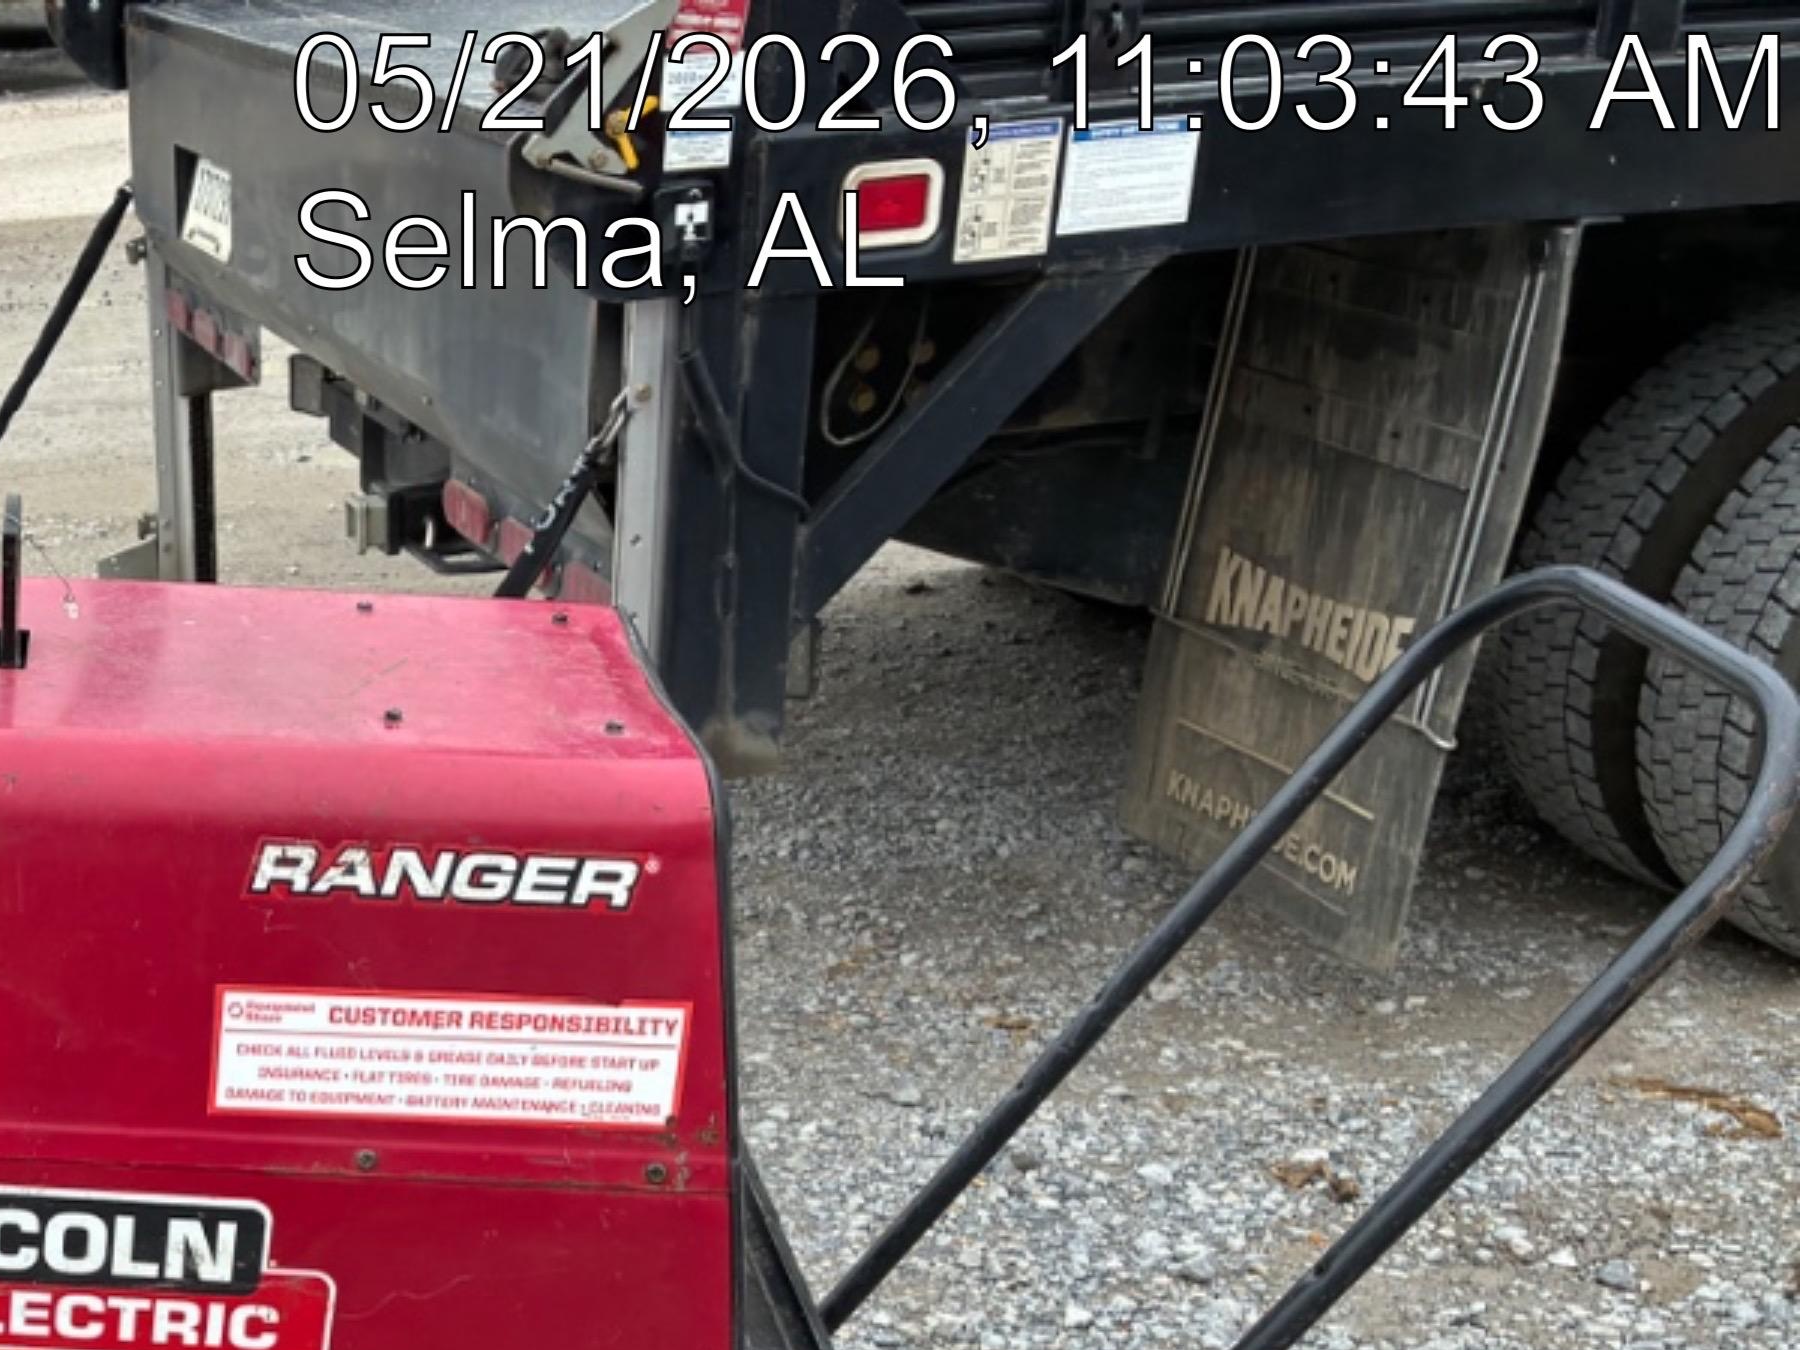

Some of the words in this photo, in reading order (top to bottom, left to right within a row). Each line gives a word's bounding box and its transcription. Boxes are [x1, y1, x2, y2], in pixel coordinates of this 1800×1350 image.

[1166, 769, 1358, 895] KNAPHE.COM
[251, 842, 640, 908] RANGER
[328, 1005, 462, 1030] CUSTOMER
[469, 1010, 679, 1036] RESPONSIBILITY
[236, 1042, 281, 1057] CHECK
[286, 1045, 310, 1058] ALL
[313, 1045, 357, 1060] FLUID
[359, 1047, 411, 1062] LEVELS
[428, 1049, 482, 1065] GREASE
[486, 1052, 528, 1066] DAILY
[530, 1053, 586, 1068] BEFORE
[590, 1055, 637, 1070] START
[638, 1058, 661, 1072] UP
[257, 1066, 340, 1081] INSURANCE
[352, 1070, 385, 1084] FLAT
[389, 1071, 433, 1085] TIRES
[443, 1073, 475, 1087] TIRE
[479, 1075, 541, 1090] DAMAGE
[551, 1077, 633, 1093] REFUELING
[225, 1086, 285, 1102] DAMAGE
[289, 1088, 306, 1103] TO
[309, 1090, 396, 1106] EQUIPMENT
[405, 1094, 468, 1109] BATTERY
[471, 1096, 576, 1115] MAINTENANCE
[586, 1101, 661, 1117] CLEANING
